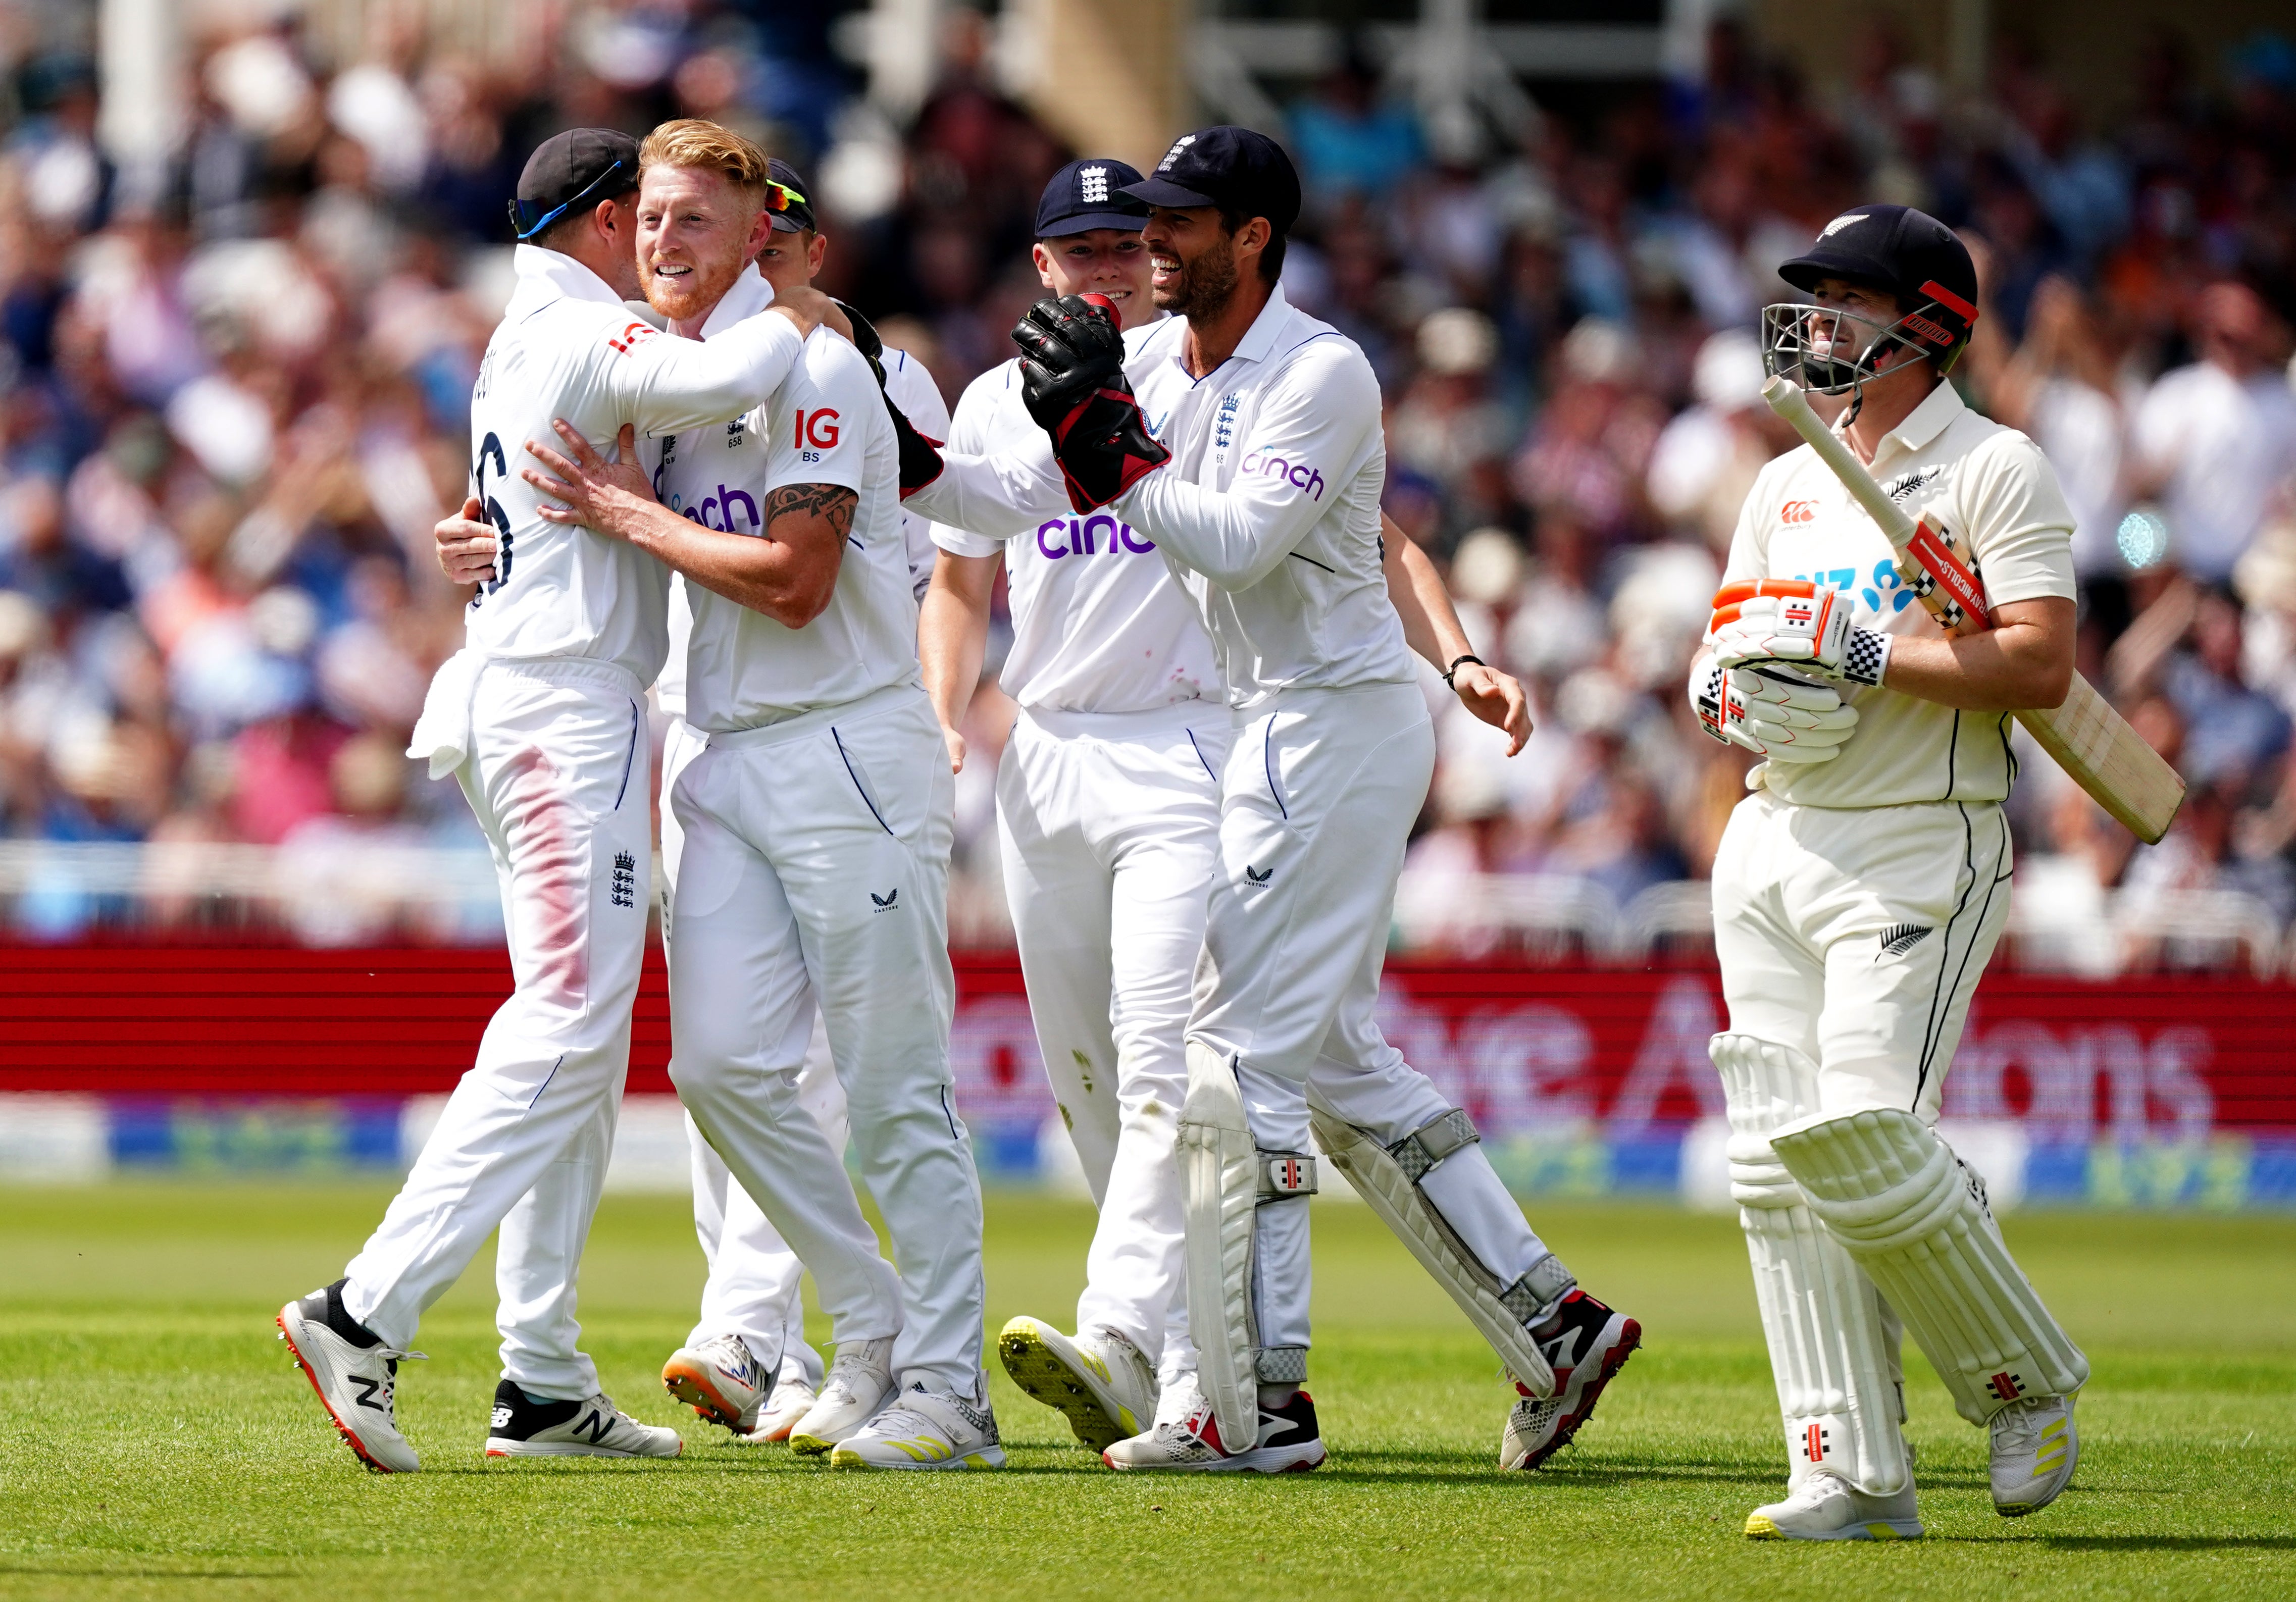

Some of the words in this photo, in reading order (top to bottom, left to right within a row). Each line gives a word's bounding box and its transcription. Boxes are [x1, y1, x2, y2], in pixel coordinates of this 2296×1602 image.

[728, 435, 742, 448] 658
[794, 408, 840, 449] IG
[802, 451, 819, 462] BS
[1242, 445, 1324, 502] cinch
[1037, 511, 1157, 560] cinc
[874, 905, 898, 913] CASTORE
